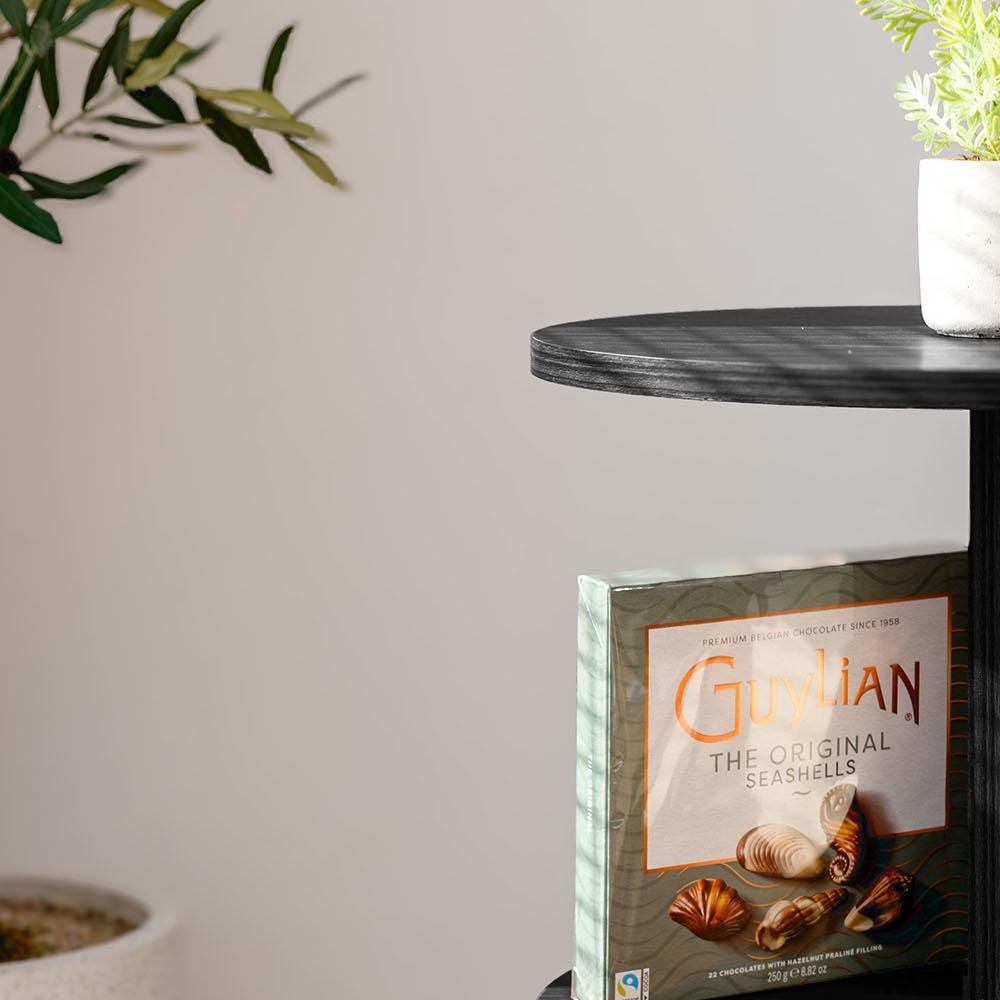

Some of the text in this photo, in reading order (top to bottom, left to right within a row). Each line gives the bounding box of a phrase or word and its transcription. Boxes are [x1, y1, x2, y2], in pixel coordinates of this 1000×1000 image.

[702, 617, 900, 647] PREMIUM BELGIAN CHOCOLATE SINCE 1958
[709, 731, 891, 773] THE ORIGINAL
[745, 759, 856, 788] SEASHELLS
[708, 971, 718, 979] 22
[719, 964, 766, 977] CHOCOLATES
[767, 959, 786, 969] WITH
[787, 954, 824, 966] HAZELNUT
[856, 944, 883, 955] FILLING
[767, 972, 782, 983] 250
[801, 965, 817, 977] 8.82
[818, 965, 828, 974] oz
